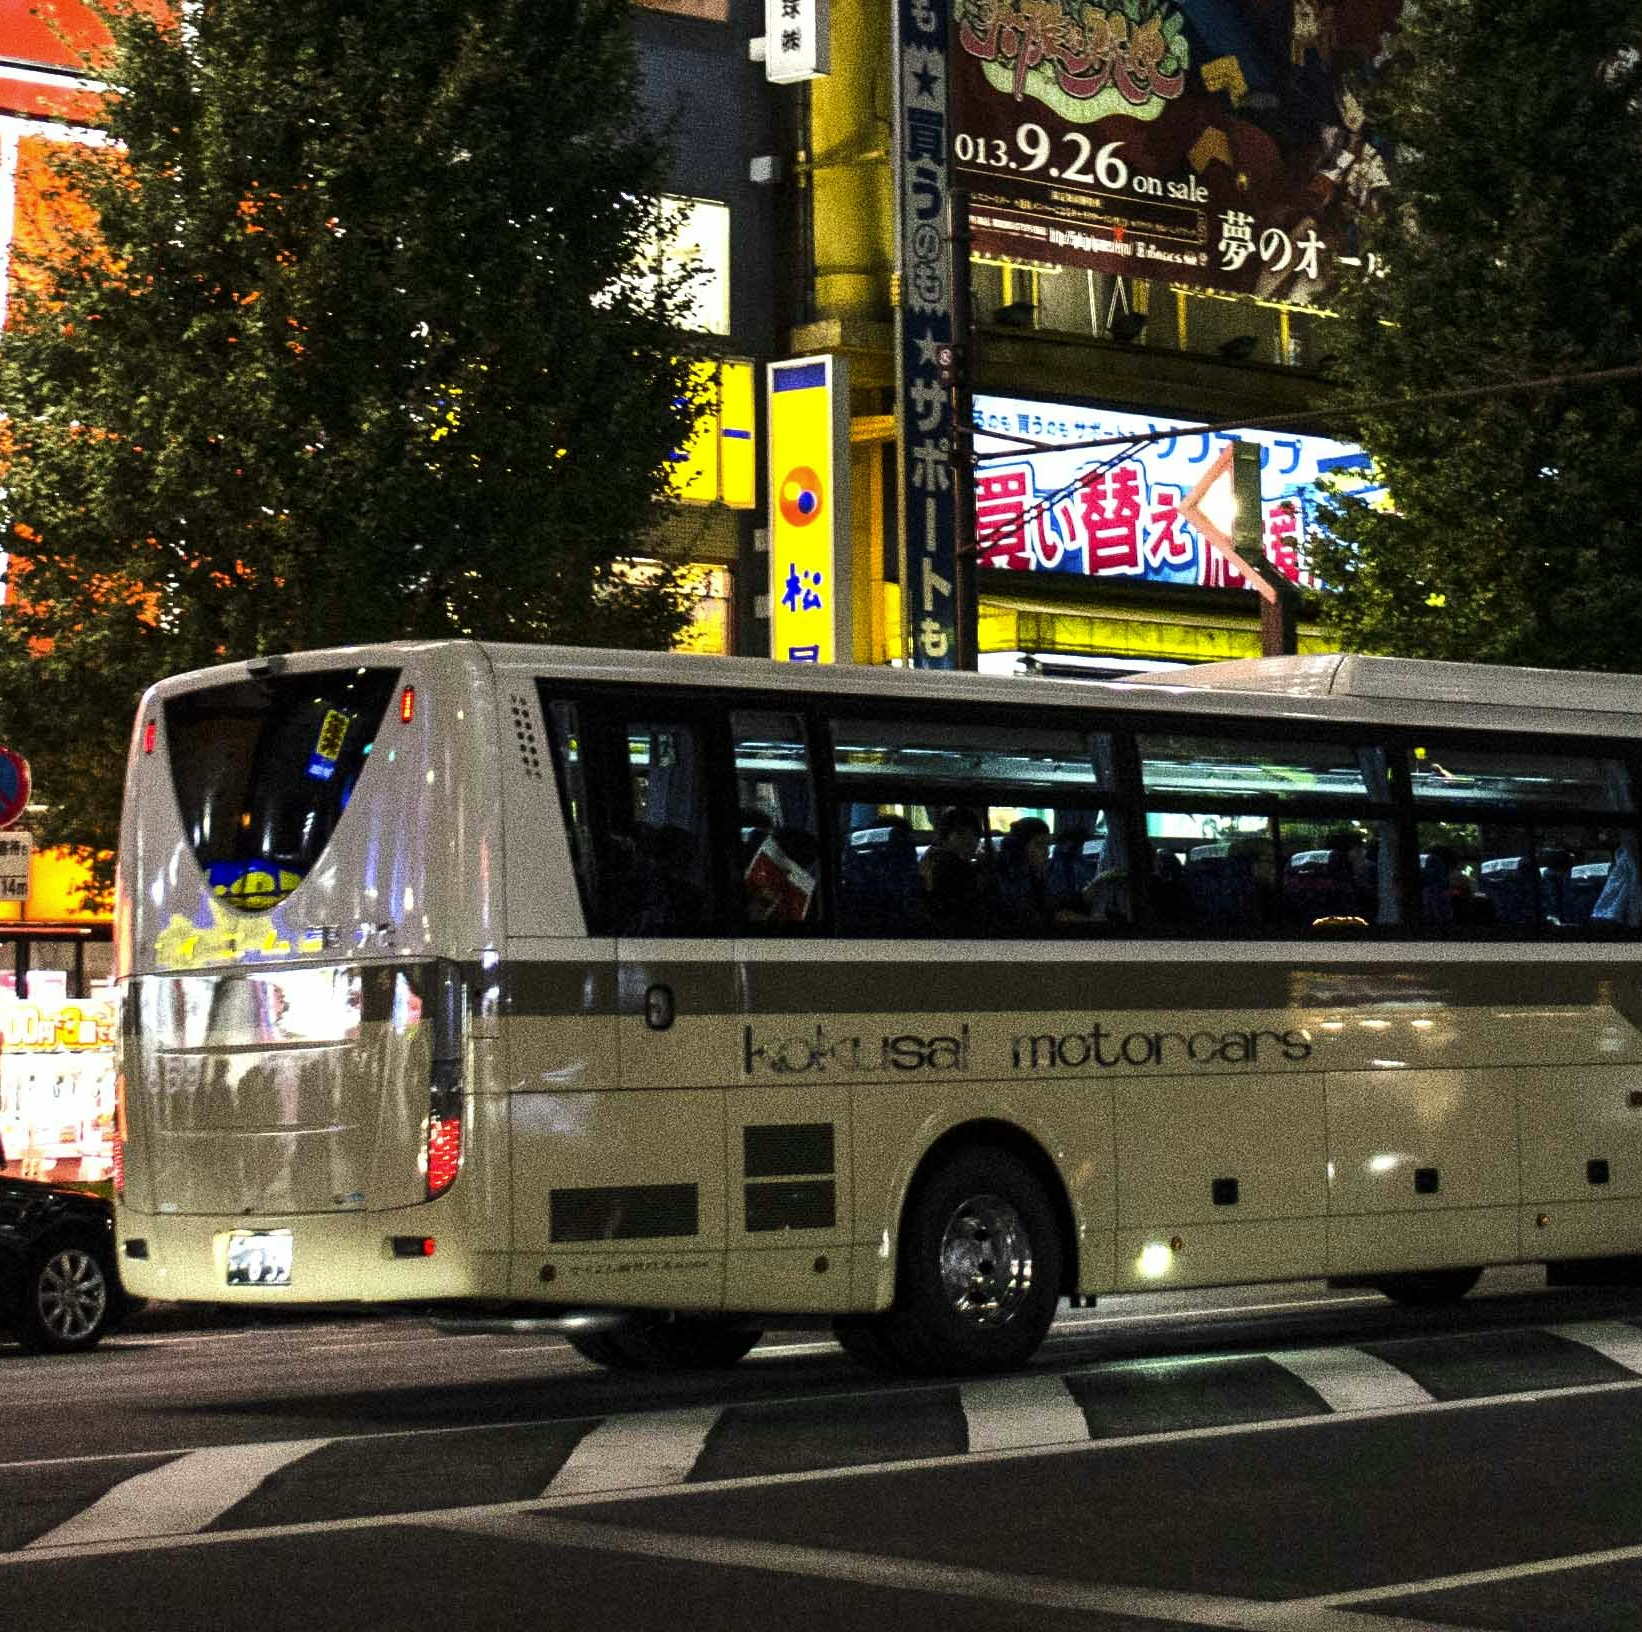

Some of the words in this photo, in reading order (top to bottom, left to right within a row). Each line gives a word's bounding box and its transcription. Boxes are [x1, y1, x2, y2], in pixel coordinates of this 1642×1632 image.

[906, 106, 946, 303] 買うのも
[954, 122, 1129, 190] 013.9.26
[1132, 174, 1162, 197] on
[1166, 173, 1209, 204] sale
[909, 377, 954, 658] サポートも
[1011, 1020, 1314, 1069] motorcars
